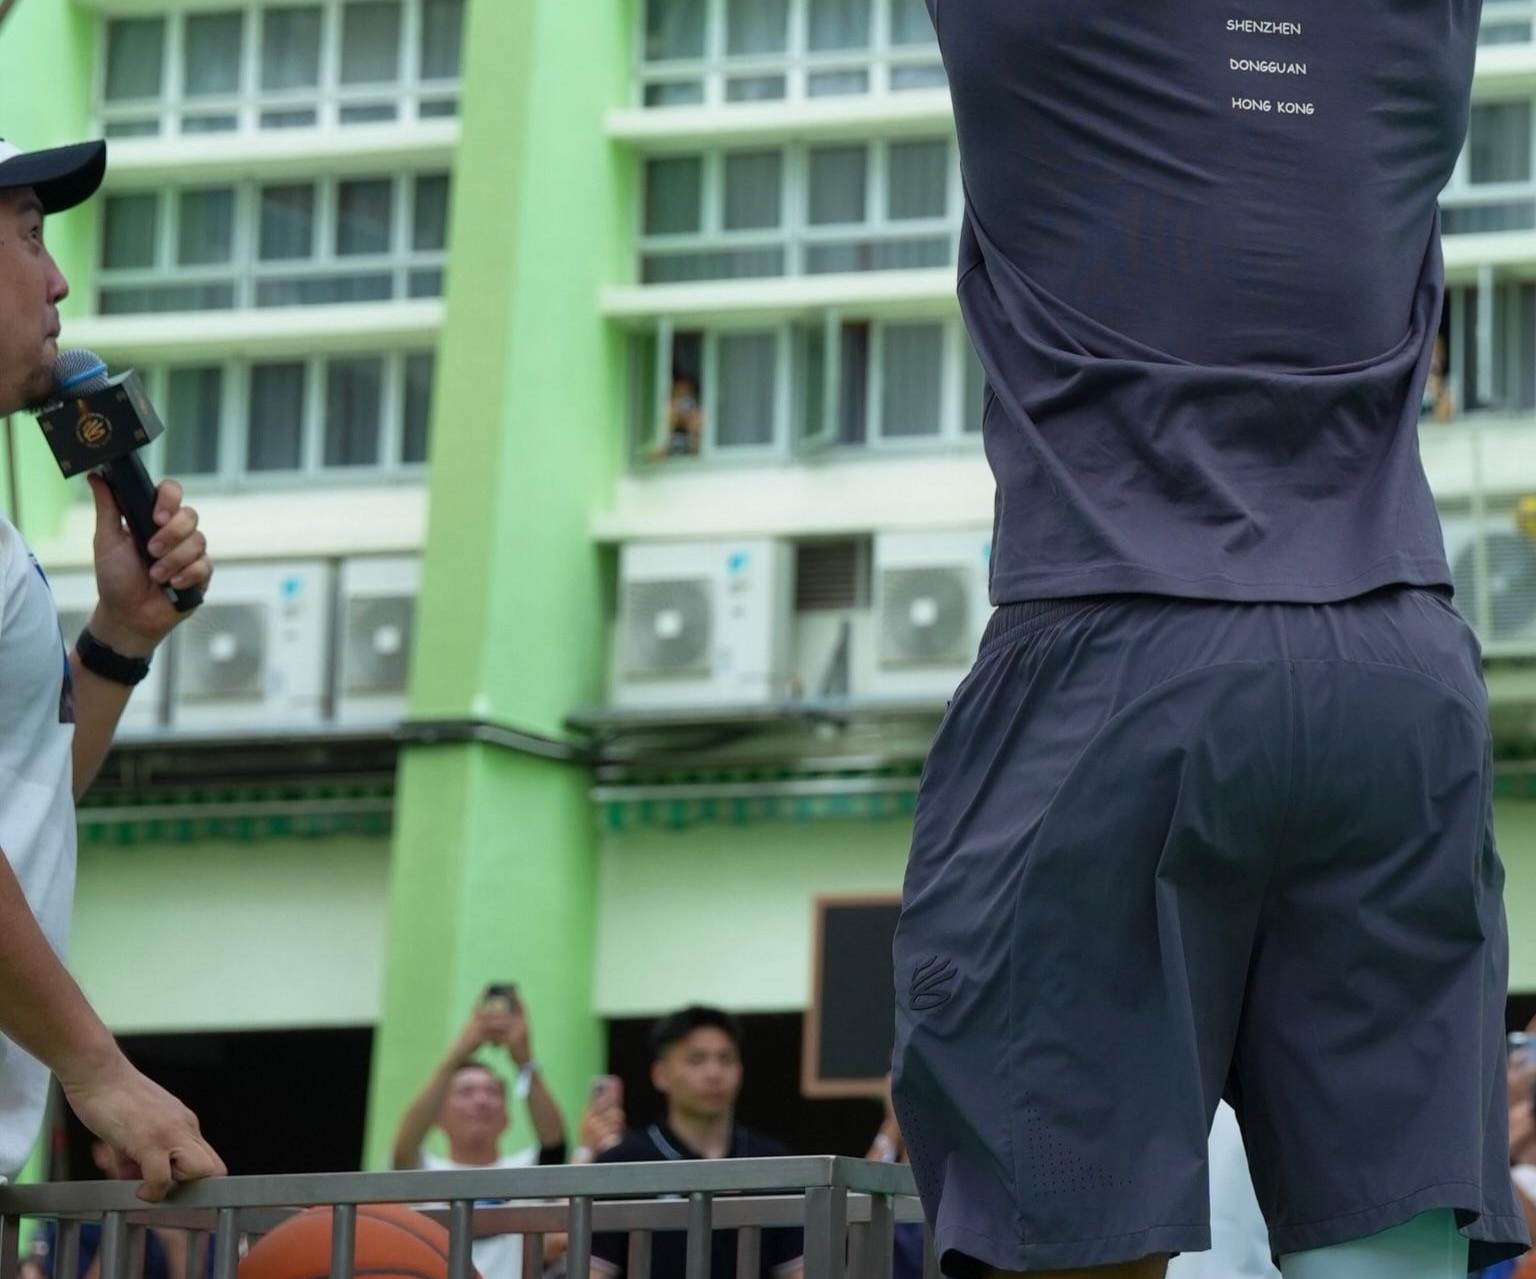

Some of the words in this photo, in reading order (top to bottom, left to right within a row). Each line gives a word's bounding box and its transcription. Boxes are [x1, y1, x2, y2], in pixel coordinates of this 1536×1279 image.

[1226, 19, 1302, 35] SHENZHEN
[1229, 58, 1307, 75] DONGGUAN
[1231, 97, 1272, 112] HONG
[1277, 101, 1315, 115] KONG
